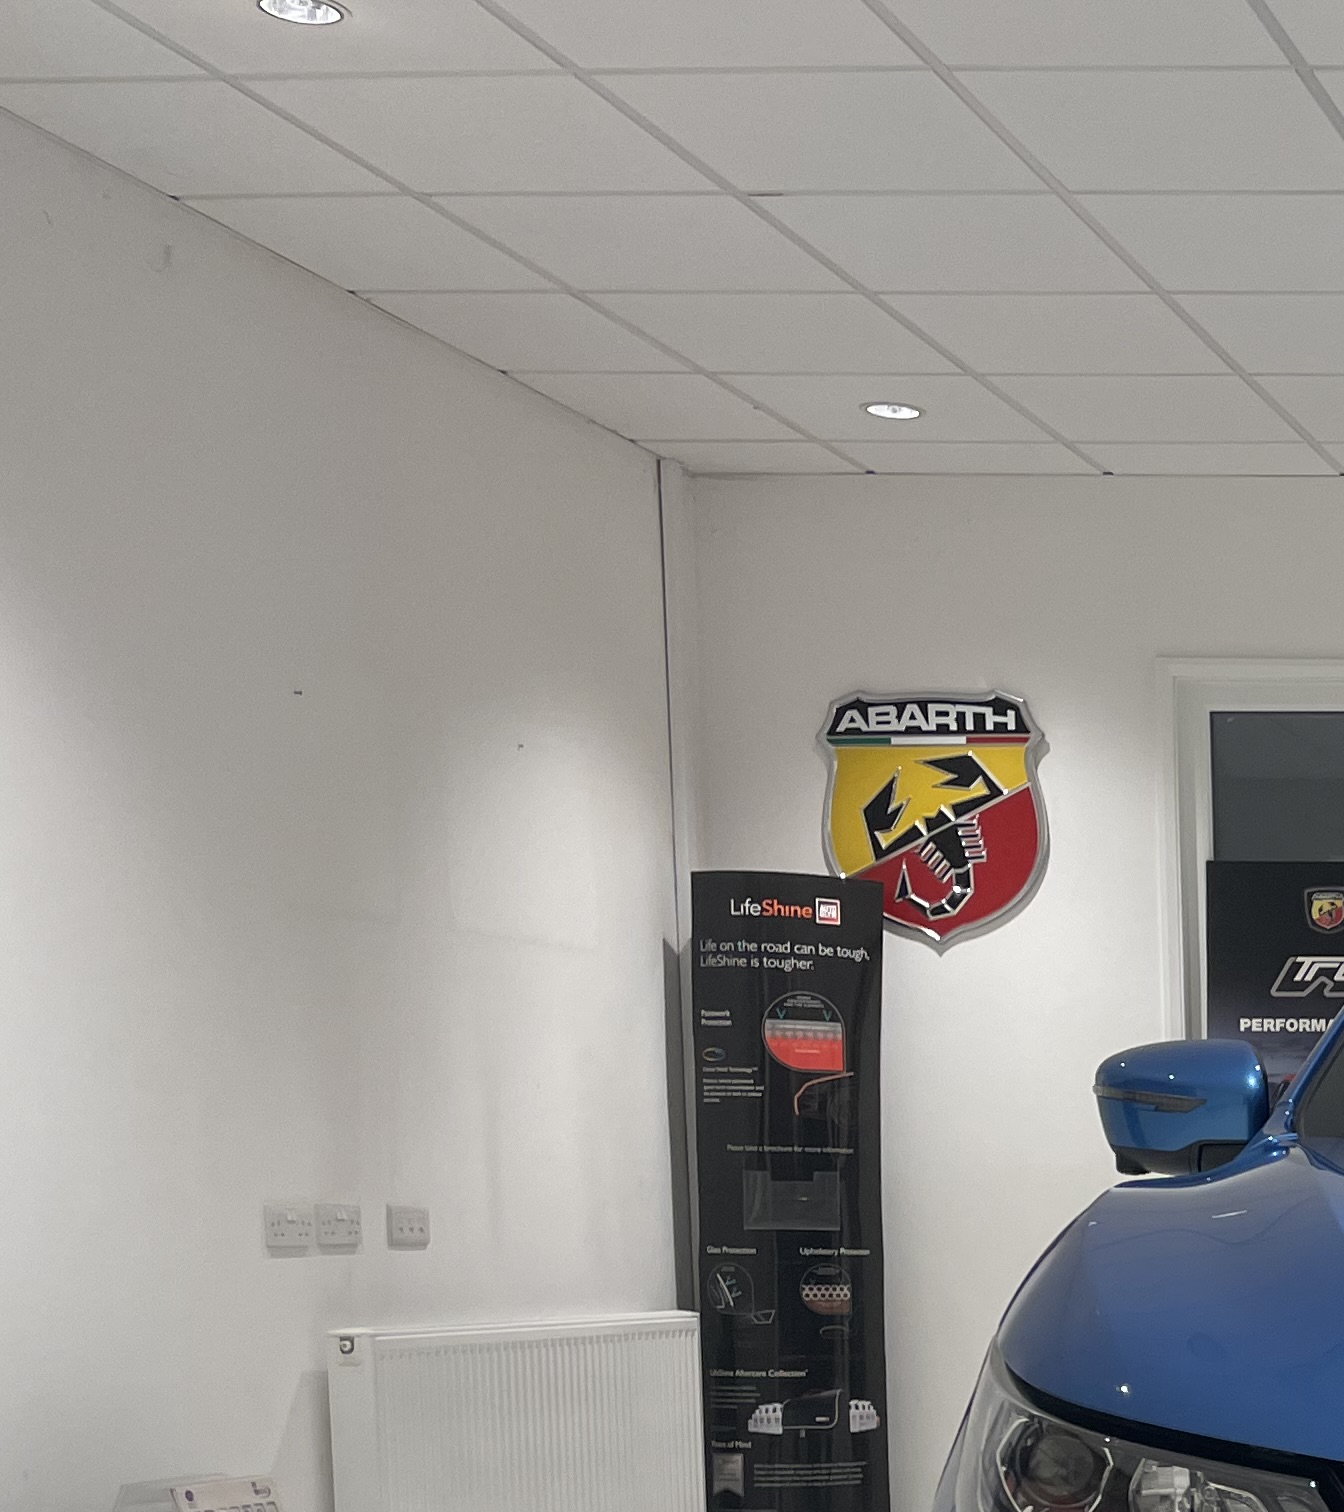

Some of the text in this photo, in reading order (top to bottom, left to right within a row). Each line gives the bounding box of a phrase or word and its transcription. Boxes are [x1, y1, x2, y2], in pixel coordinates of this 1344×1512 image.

[836, 703, 1016, 732] ABARTH
[730, 898, 813, 919] LifeShine
[700, 938, 717, 952] Life
[719, 941, 734, 951] on
[737, 940, 758, 952] the
[761, 941, 790, 953] road
[794, 944, 815, 956] can
[818, 943, 834, 957] be
[700, 955, 747, 968] LifeShine
[750, 955, 760, 968] is
